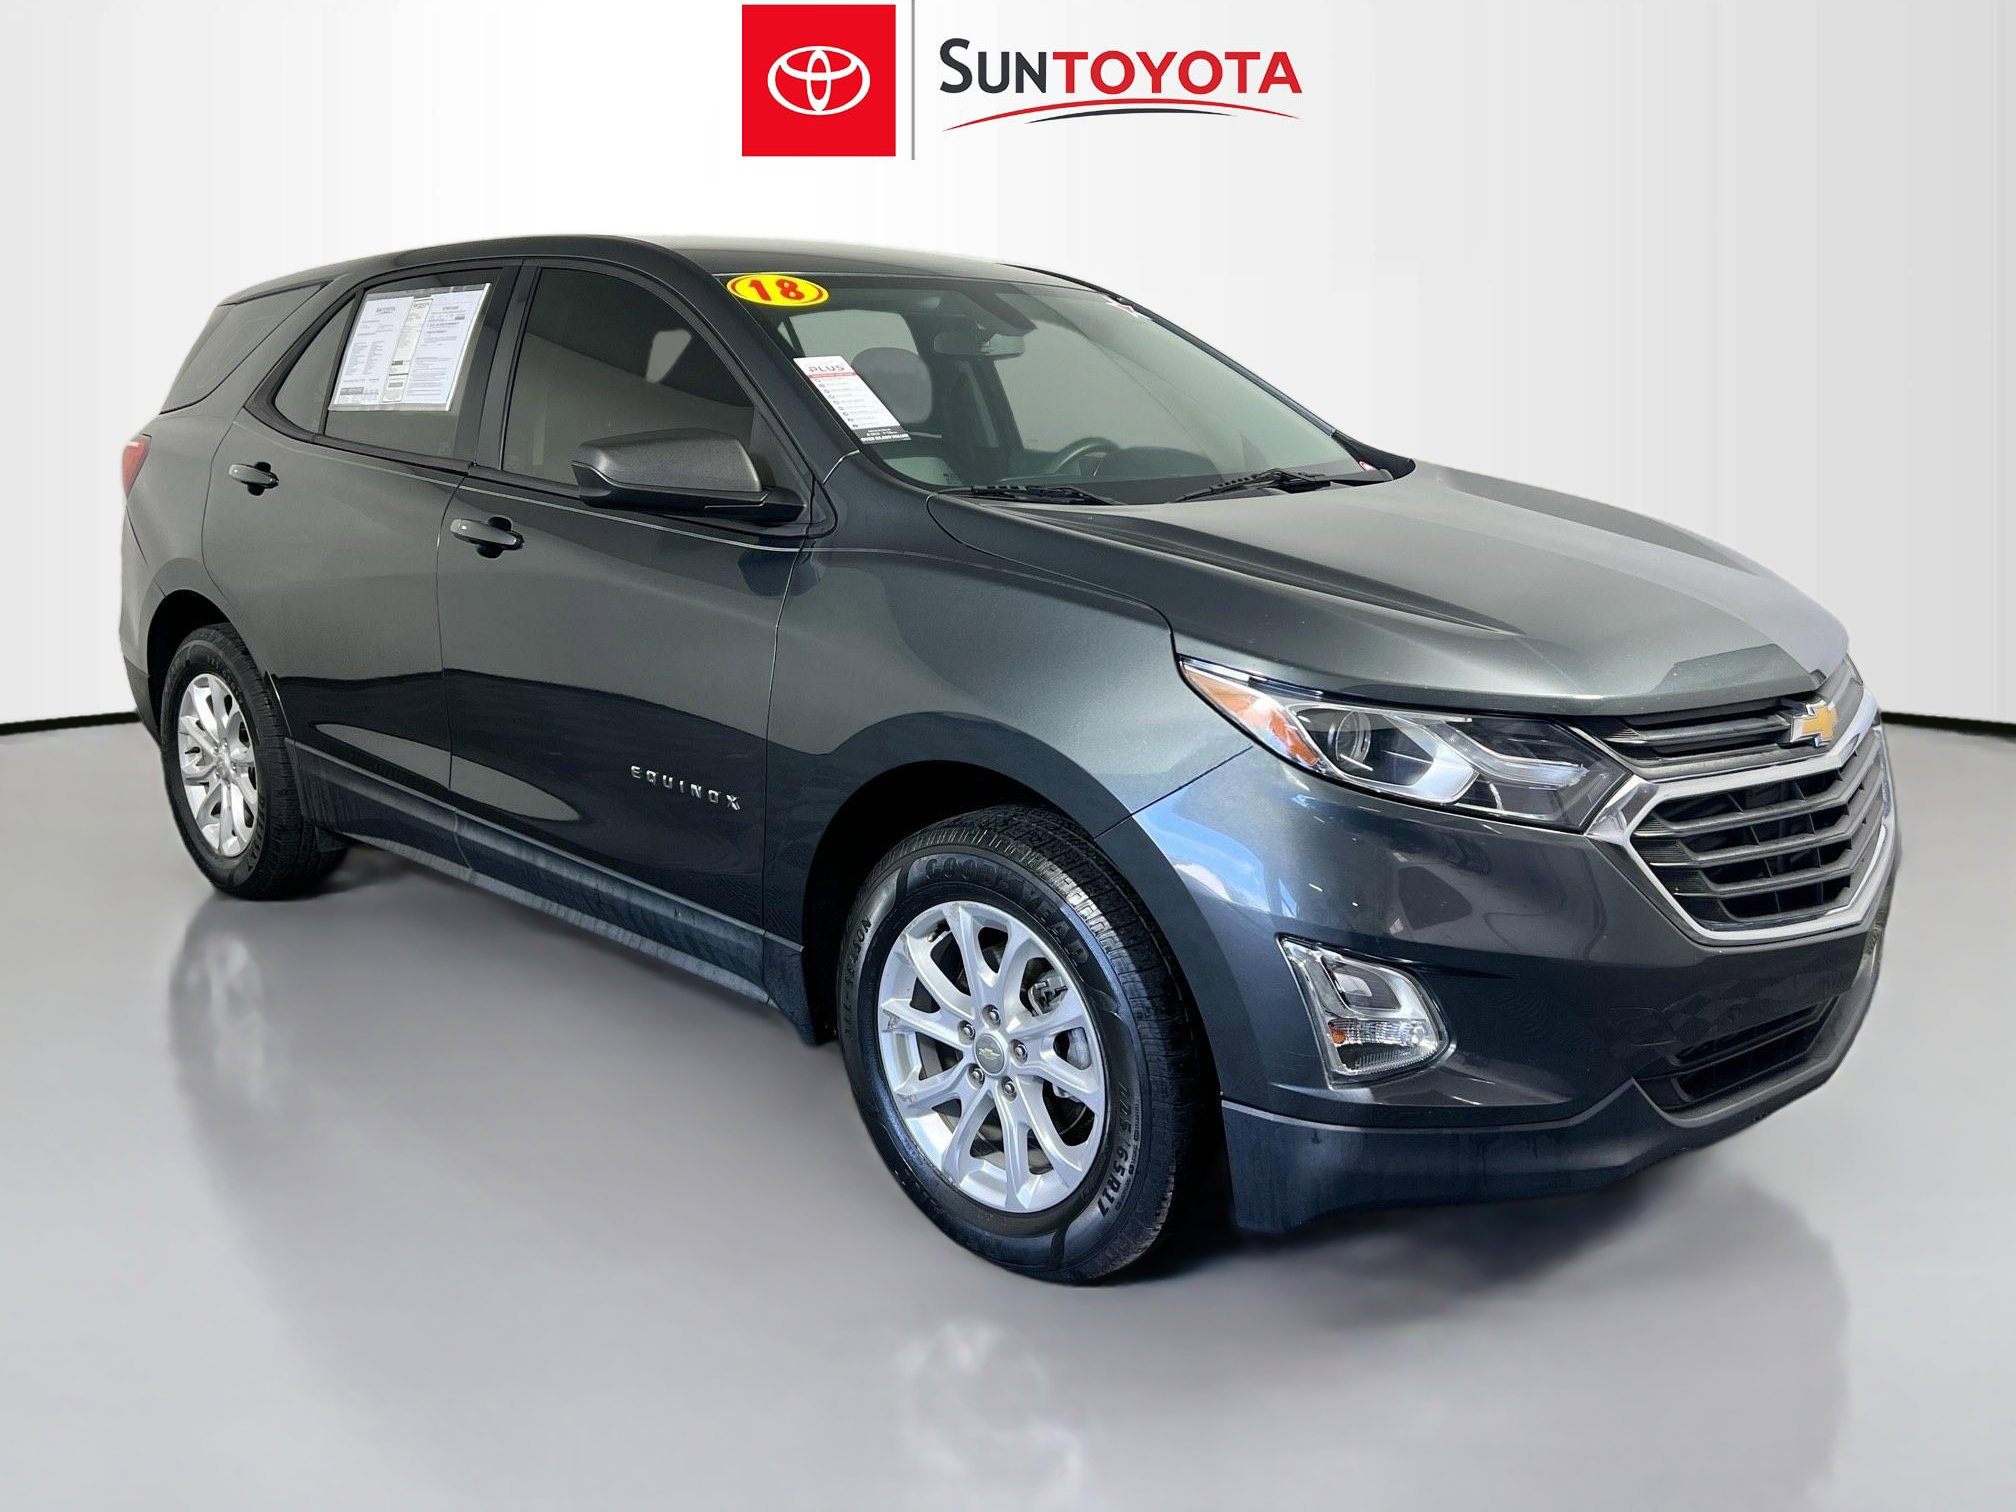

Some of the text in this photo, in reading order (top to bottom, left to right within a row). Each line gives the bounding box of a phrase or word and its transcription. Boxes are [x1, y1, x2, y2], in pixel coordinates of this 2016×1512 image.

[748, 279, 805, 301] 18
[808, 364, 845, 373] PLUS
[630, 765, 742, 811] EQUINOX
